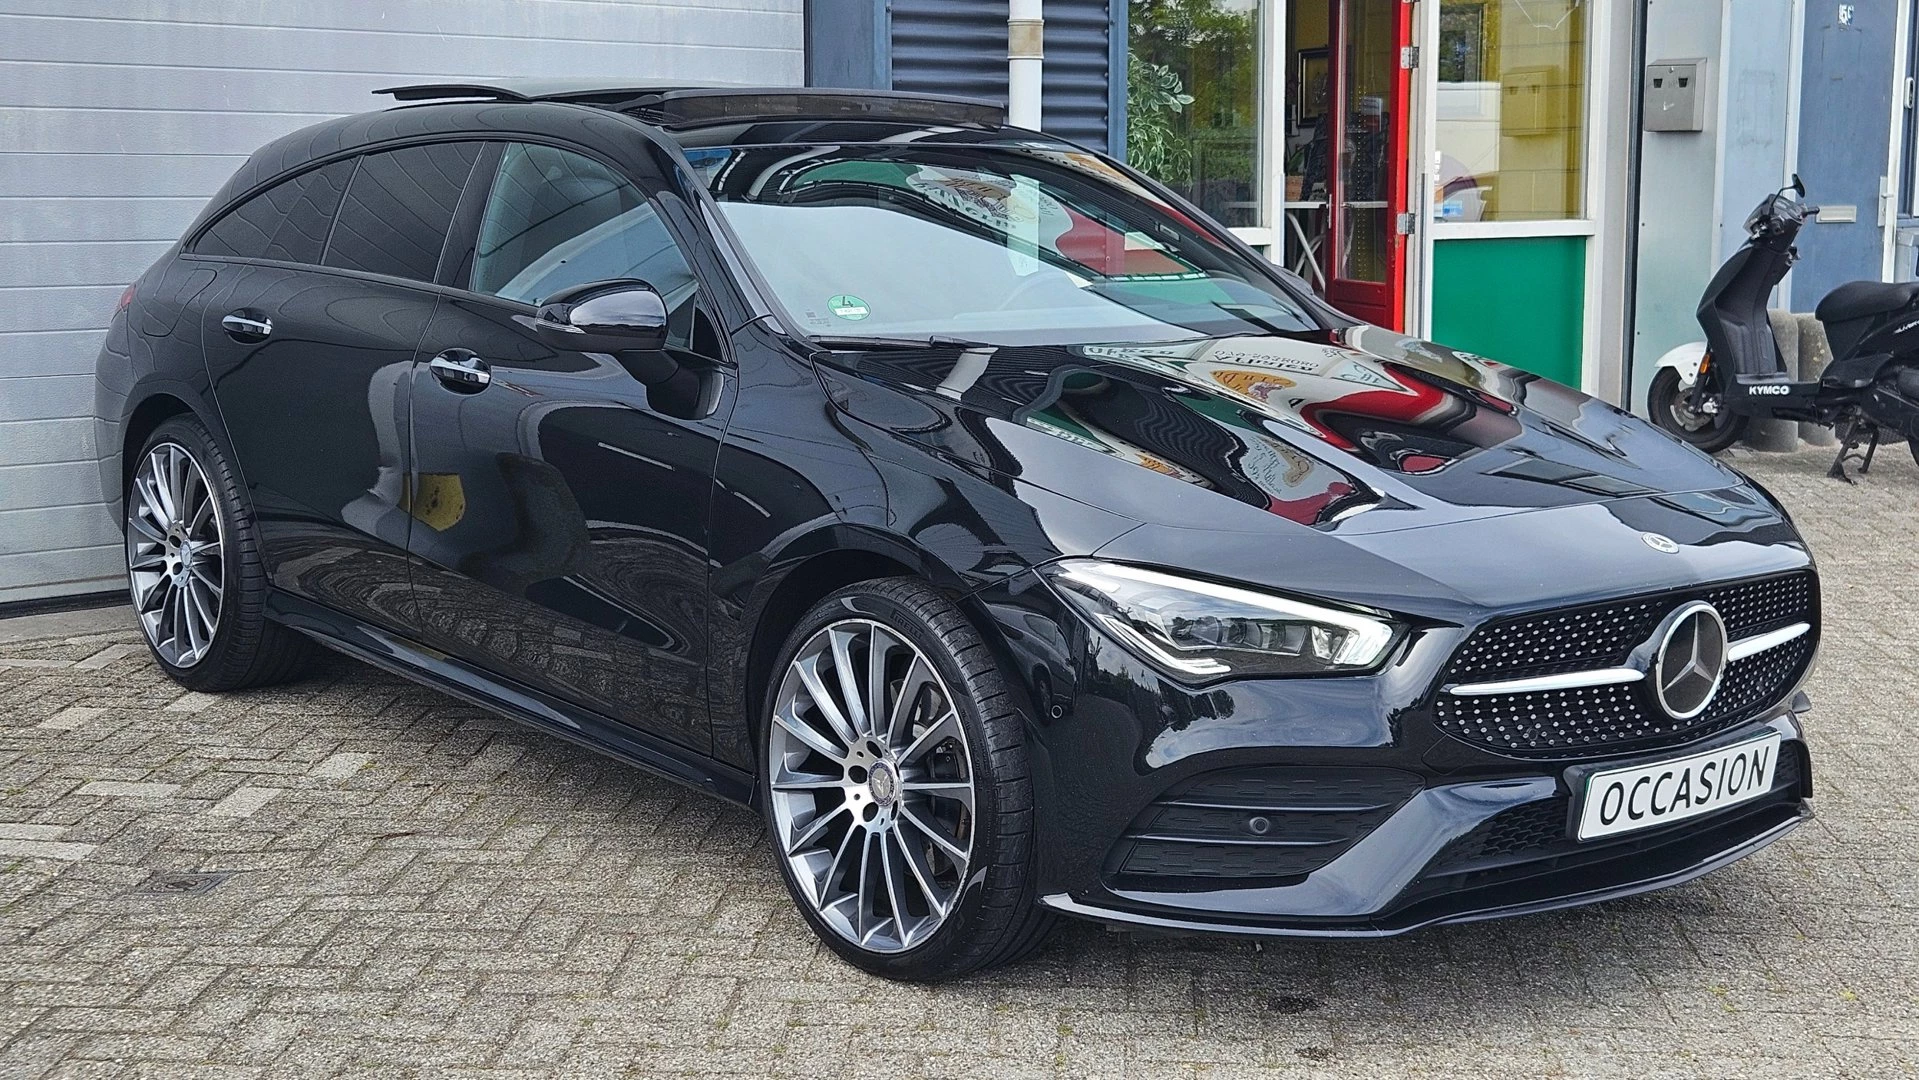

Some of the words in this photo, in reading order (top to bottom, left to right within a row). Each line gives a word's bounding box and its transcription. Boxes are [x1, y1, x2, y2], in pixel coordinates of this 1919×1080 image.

[1748, 385, 1790, 395] KYMCO
[889, 607, 925, 639] PIRELLI
[1600, 746, 1770, 825] OCCASION
